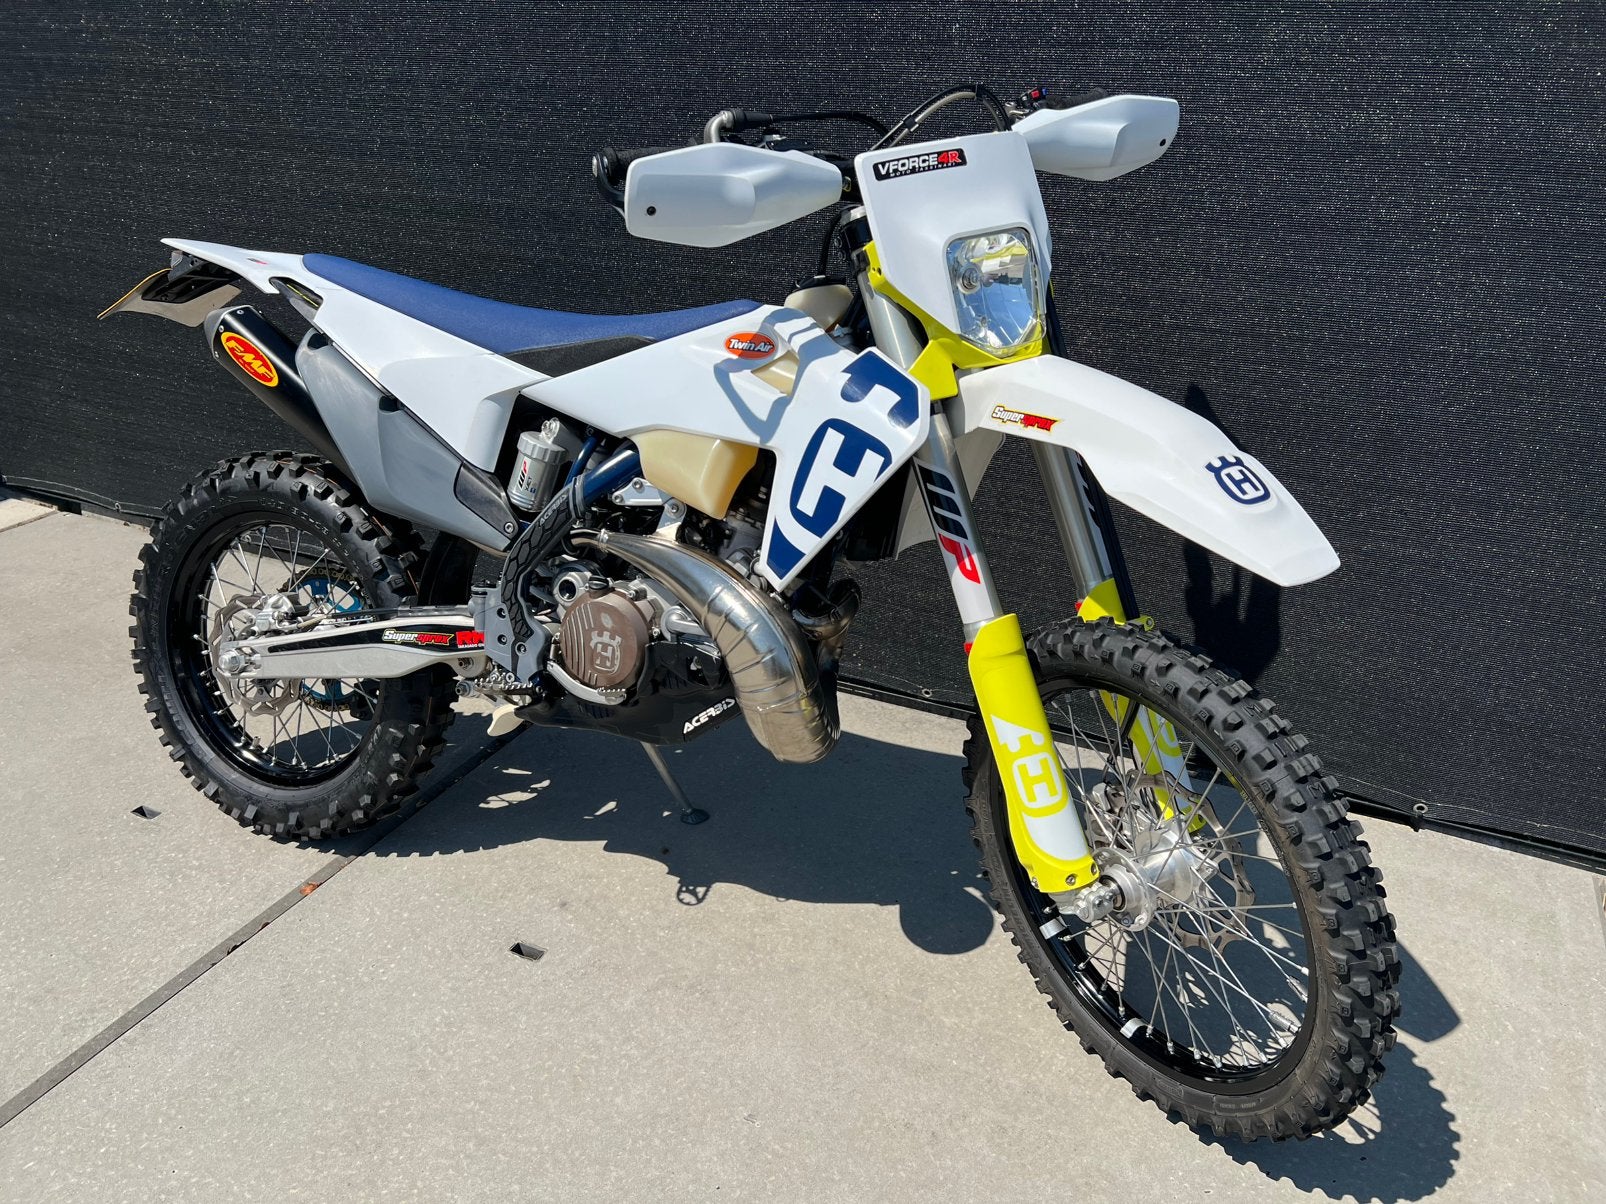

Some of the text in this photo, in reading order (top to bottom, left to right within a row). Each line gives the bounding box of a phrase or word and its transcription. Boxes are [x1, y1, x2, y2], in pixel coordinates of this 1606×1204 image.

[877, 150, 962, 175] VFORCE4R
[729, 339, 773, 352] Twin Air
[225, 340, 275, 378] FMF
